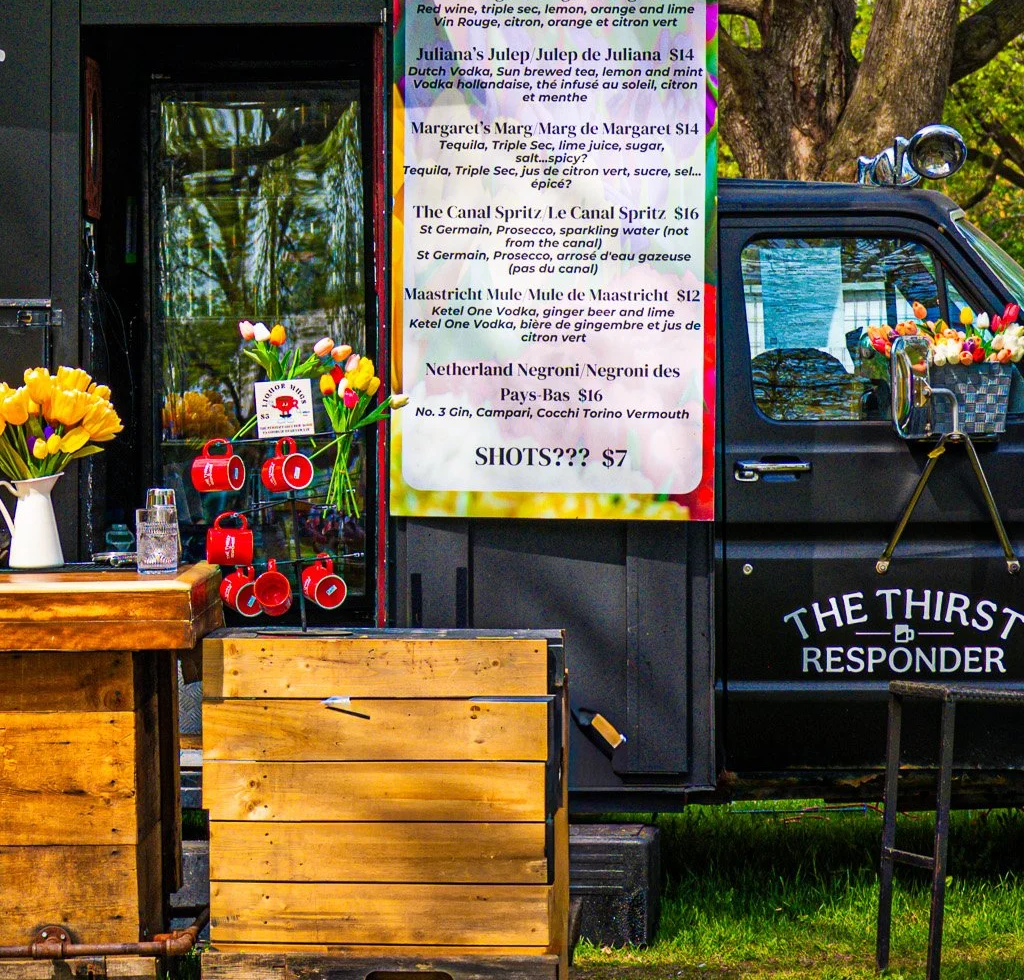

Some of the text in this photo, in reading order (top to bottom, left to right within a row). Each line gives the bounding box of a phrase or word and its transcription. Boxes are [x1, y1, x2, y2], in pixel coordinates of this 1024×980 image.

[417, 4, 694, 16] Red wine, triple sec, lemon, orange and lime
[416, 48, 484, 62] Juliana's
[582, 48, 600, 60] de
[605, 48, 661, 61] Juliana
[670, 48, 694, 61] $14
[408, 66, 703, 78] Dutch Vodka, Sun brewed tea, lemon and mint
[412, 121, 490, 137] Margaret's
[581, 122, 598, 134] de
[604, 123, 670, 138] Margaret
[676, 123, 698, 135] $14
[413, 206, 442, 218] The
[447, 206, 490, 218] Canal
[571, 207, 614, 219] Canal
[619, 207, 665, 223] Spritz
[675, 207, 698, 220] $16
[420, 224, 688, 238] St Germain, Prosecco, sparkling water (not
[405, 288, 481, 300] Maastricht
[568, 289, 585, 300] de
[590, 289, 668, 301] Maastricht
[678, 290, 700, 302] $12
[426, 363, 512, 376] Netherland
[654, 364, 680, 377] des
[501, 388, 602, 405] Pays-Bas $16
[416, 407, 689, 419] No. 3 Gin, Campari, Cocchi Torino Vermouth
[476, 448, 627, 468] SHOTS??? $7
[783, 588, 1024, 640] THE THIRST
[802, 646, 1006, 673] RESPONDER
